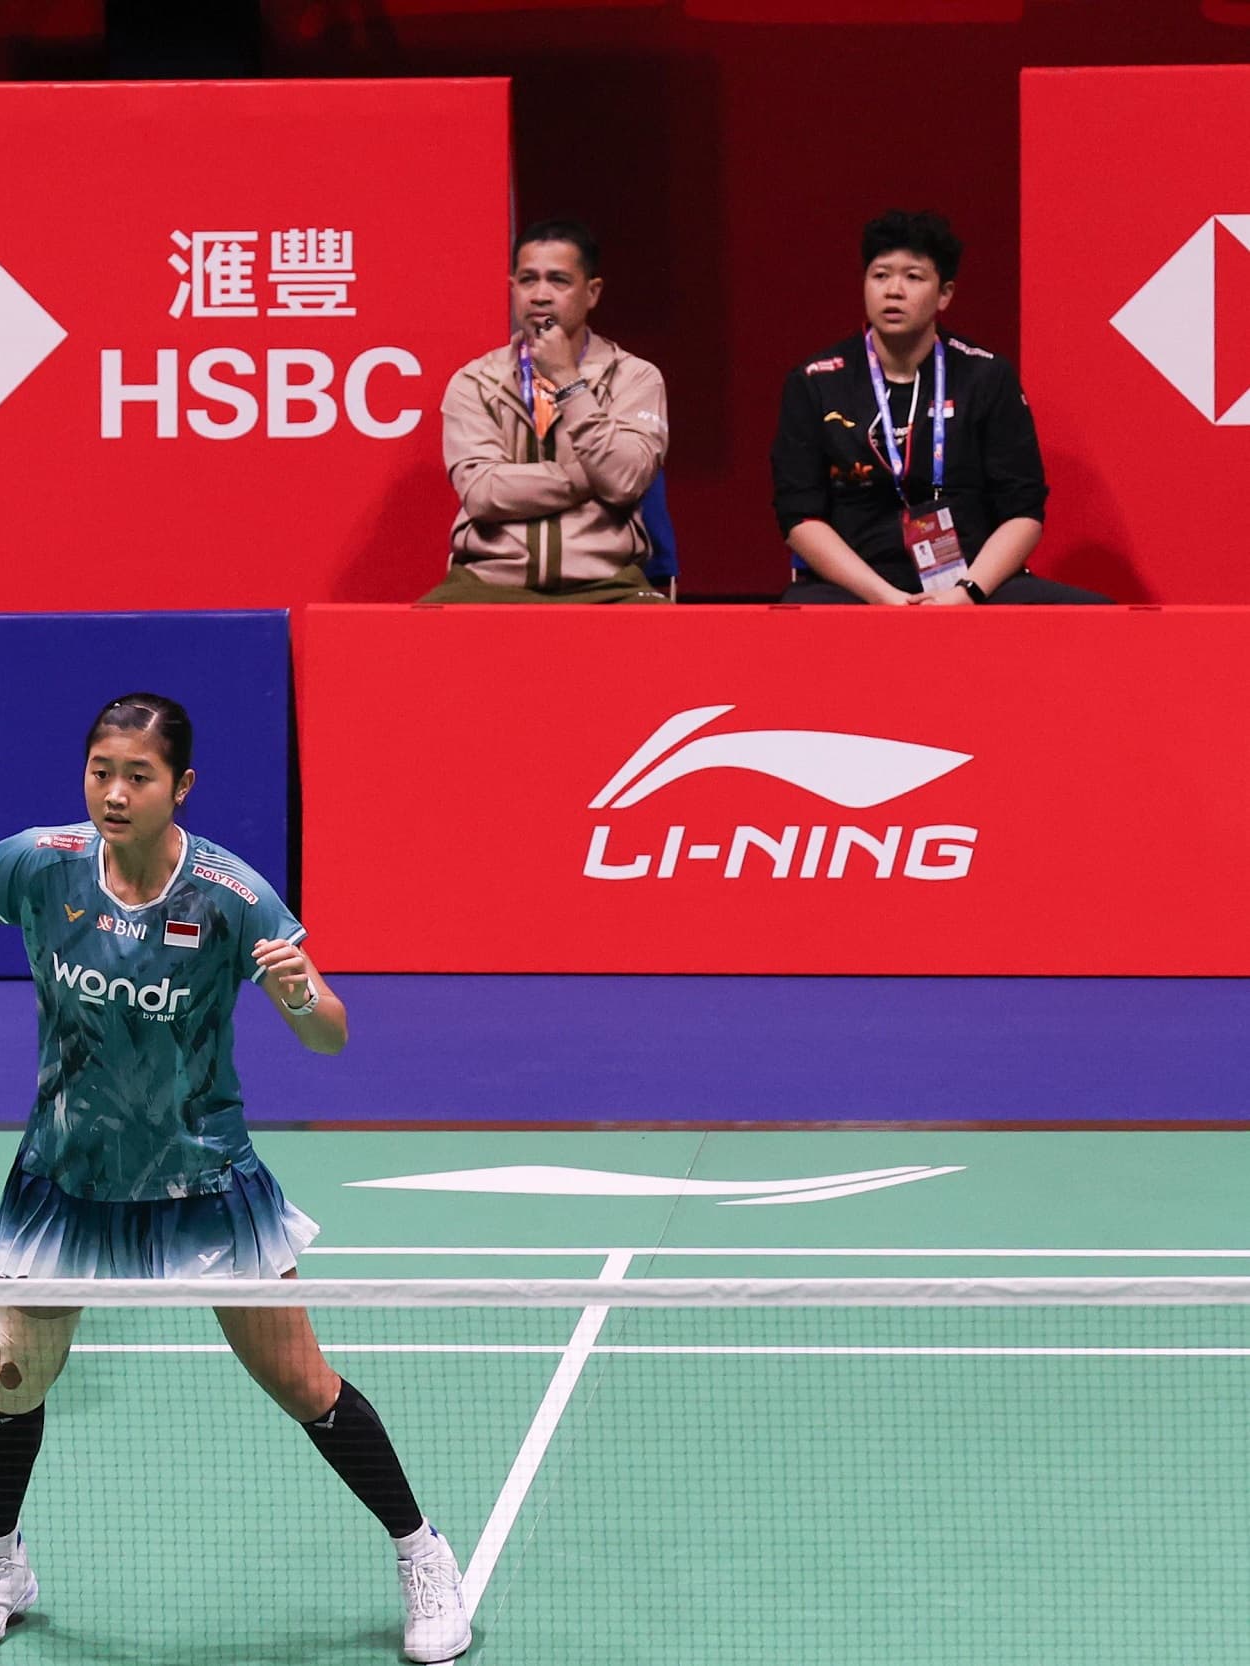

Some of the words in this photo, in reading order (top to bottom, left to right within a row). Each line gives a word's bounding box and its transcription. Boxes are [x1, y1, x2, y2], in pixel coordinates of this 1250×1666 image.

[167, 228, 357, 319] 滙豐
[101, 346, 423, 440] HSBC
[583, 824, 978, 881] LI-NING
[194, 866, 256, 903] POLYTRON
[114, 918, 148, 940] BNI
[52, 951, 190, 1013] wondr
[143, 1012, 156, 1021] by
[156, 1013, 175, 1022] BNI
